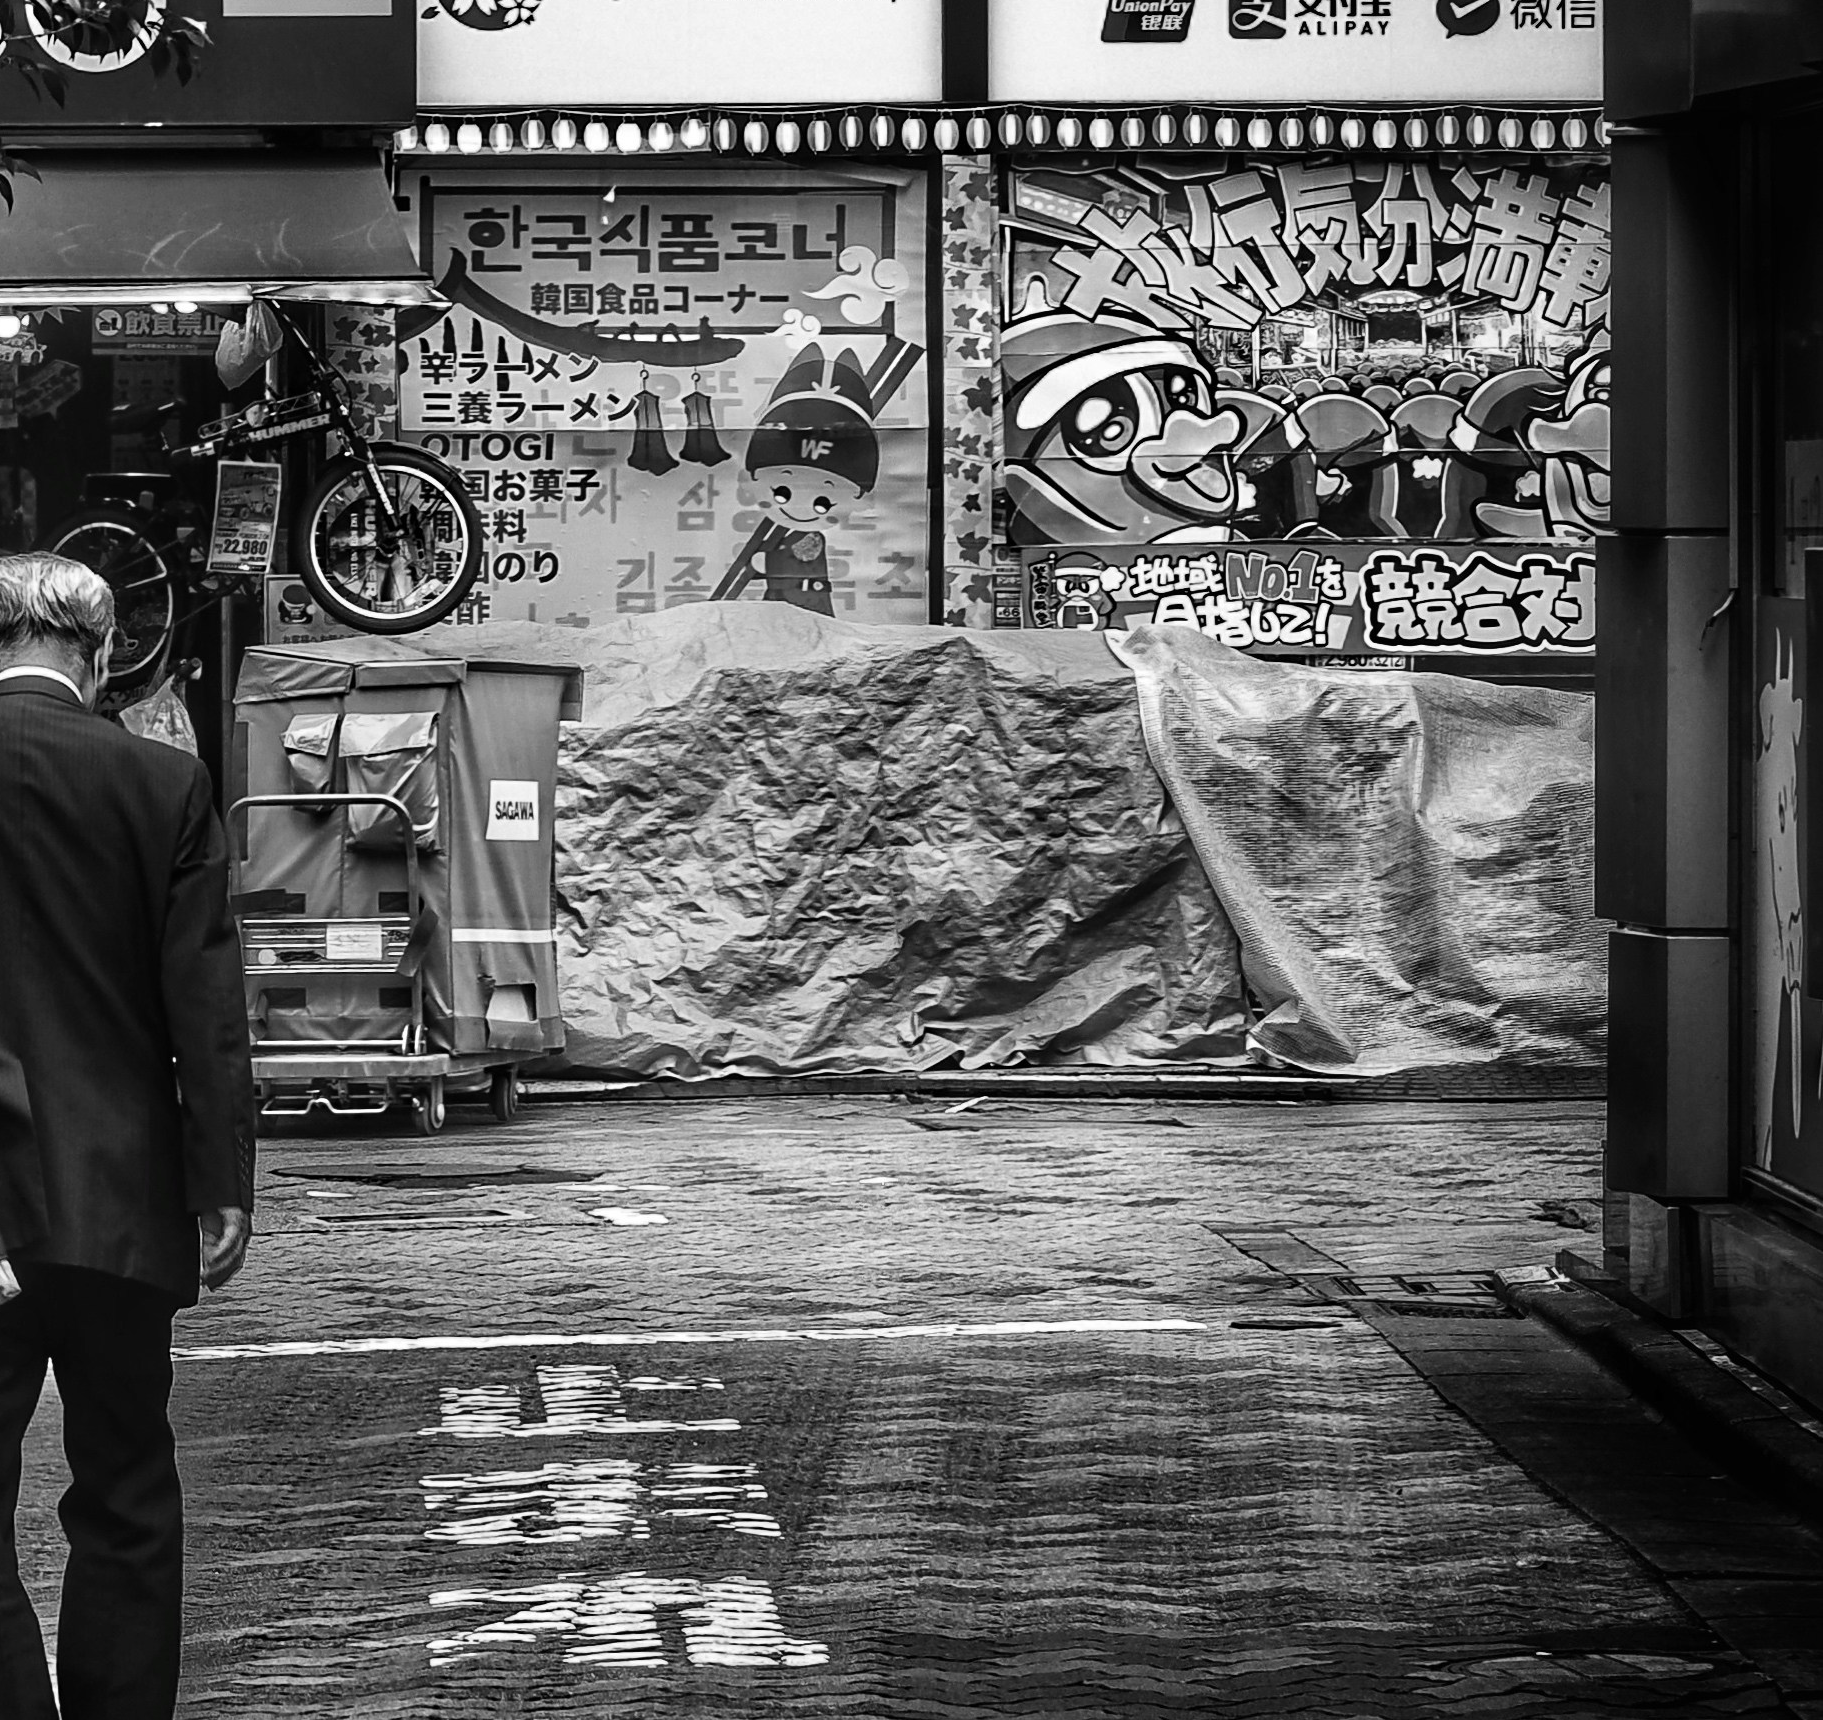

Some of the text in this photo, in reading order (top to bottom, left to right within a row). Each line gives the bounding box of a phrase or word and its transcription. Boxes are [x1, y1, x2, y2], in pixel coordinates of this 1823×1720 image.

[1298, 21, 1390, 36] ALIPAY
[463, 204, 846, 273] 한국식품코너
[530, 282, 790, 316] 韓国食品コーナー
[420, 352, 599, 385] 辛ラーメン
[421, 392, 638, 425] 三養ラーメン
[421, 433, 555, 462] OTOGI
[1129, 549, 1346, 603] 地域No.1を
[495, 801, 535, 820] SAGAWA
